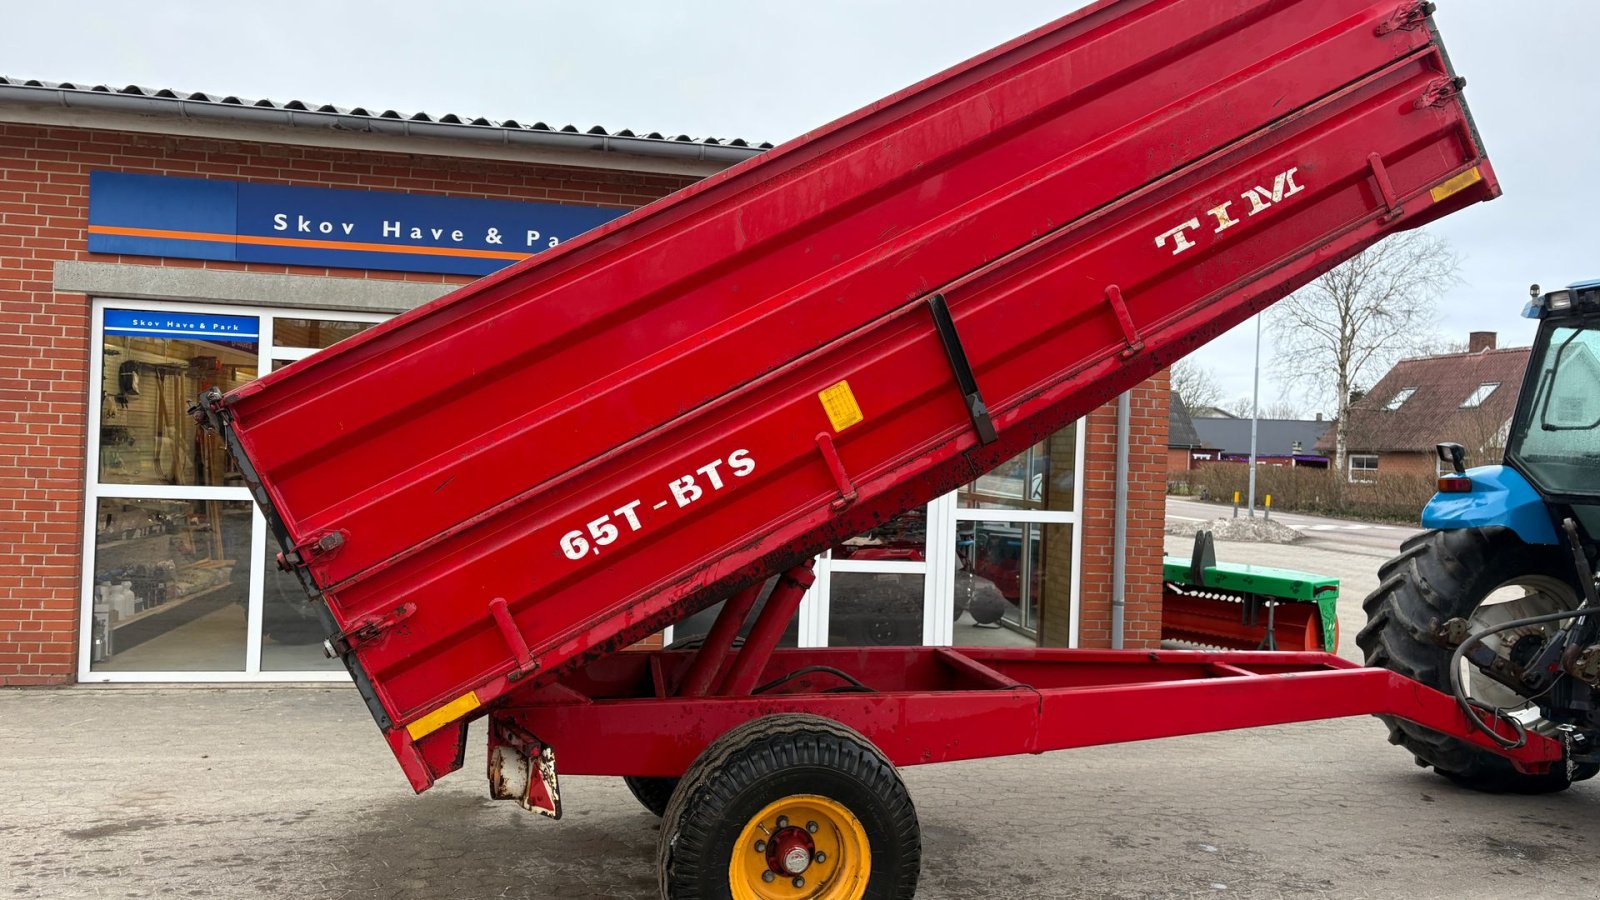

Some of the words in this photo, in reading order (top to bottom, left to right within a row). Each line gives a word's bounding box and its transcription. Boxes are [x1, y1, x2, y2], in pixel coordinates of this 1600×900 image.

[1154, 167, 1305, 256] TIM
[274, 214, 354, 235] Skov
[383, 221, 464, 242] Have
[486, 228, 503, 245] &
[527, 230, 559, 248] Pa
[132, 319, 160, 327] Skov
[166, 321, 195, 329] Have
[213, 323, 239, 331] Park
